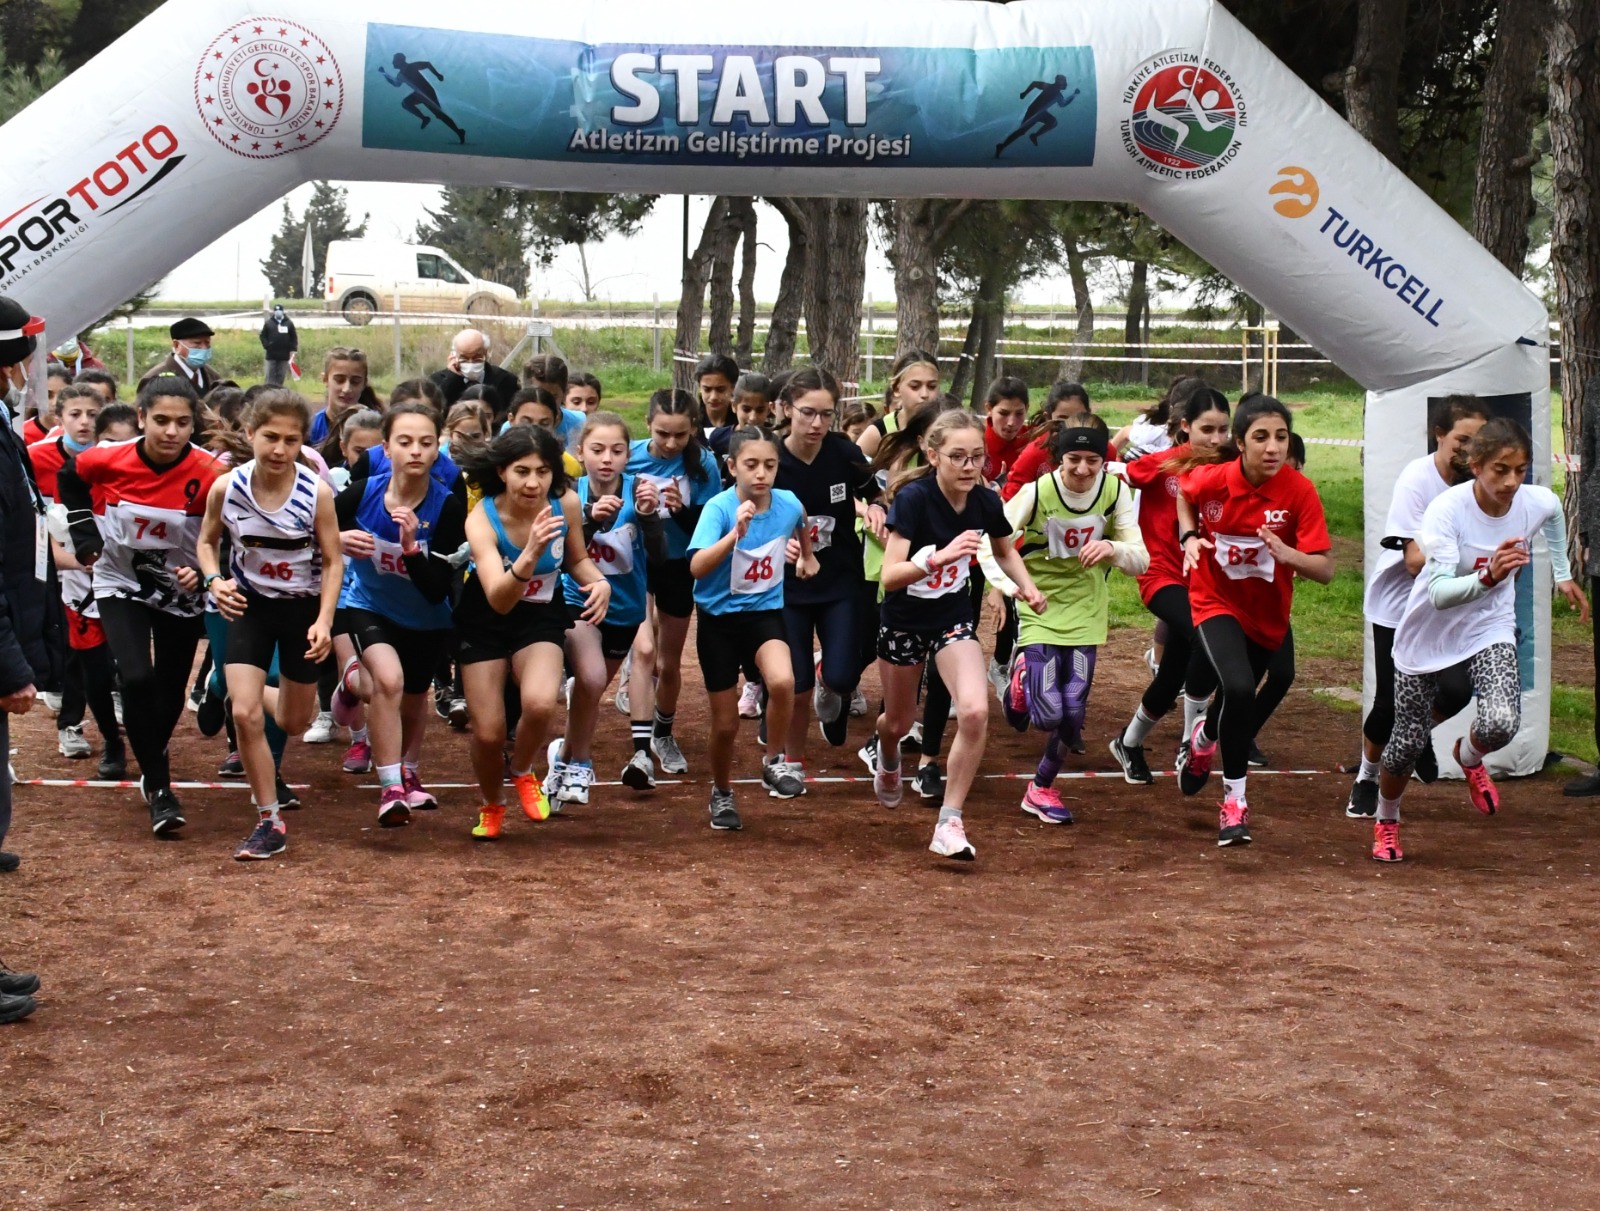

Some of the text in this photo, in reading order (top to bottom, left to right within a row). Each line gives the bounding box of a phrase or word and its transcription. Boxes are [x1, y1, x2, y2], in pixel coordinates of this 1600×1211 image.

[247, 43, 289, 53] GENÇLİK
[290, 52, 301, 63] VE
[300, 61, 316, 85] SPOR
[611, 52, 881, 126] START
[1123, 52, 1247, 127] TÜRKİYE ATLETİZM FEDERASYONU
[570, 129, 911, 161] Atletizm Geliştirme Projesi
[1120, 118, 1242, 180] TURKISH ATHLETIC FEDERATION
[66, 124, 178, 211] TOTO
[1163, 156, 1181, 167] 1922
[0, 223, 89, 291] ŞKİLAT BAŞKANLIĞI
[1319, 206, 1444, 328] TURKCELL
[134, 517, 167, 540] 74
[1064, 525, 1095, 549] 67
[588, 540, 615, 563] 40
[1228, 545, 1259, 567] 62
[1473, 557, 1495, 571] 5
[260, 561, 293, 581] 46
[744, 555, 774, 582] 48
[926, 564, 959, 589] 33
